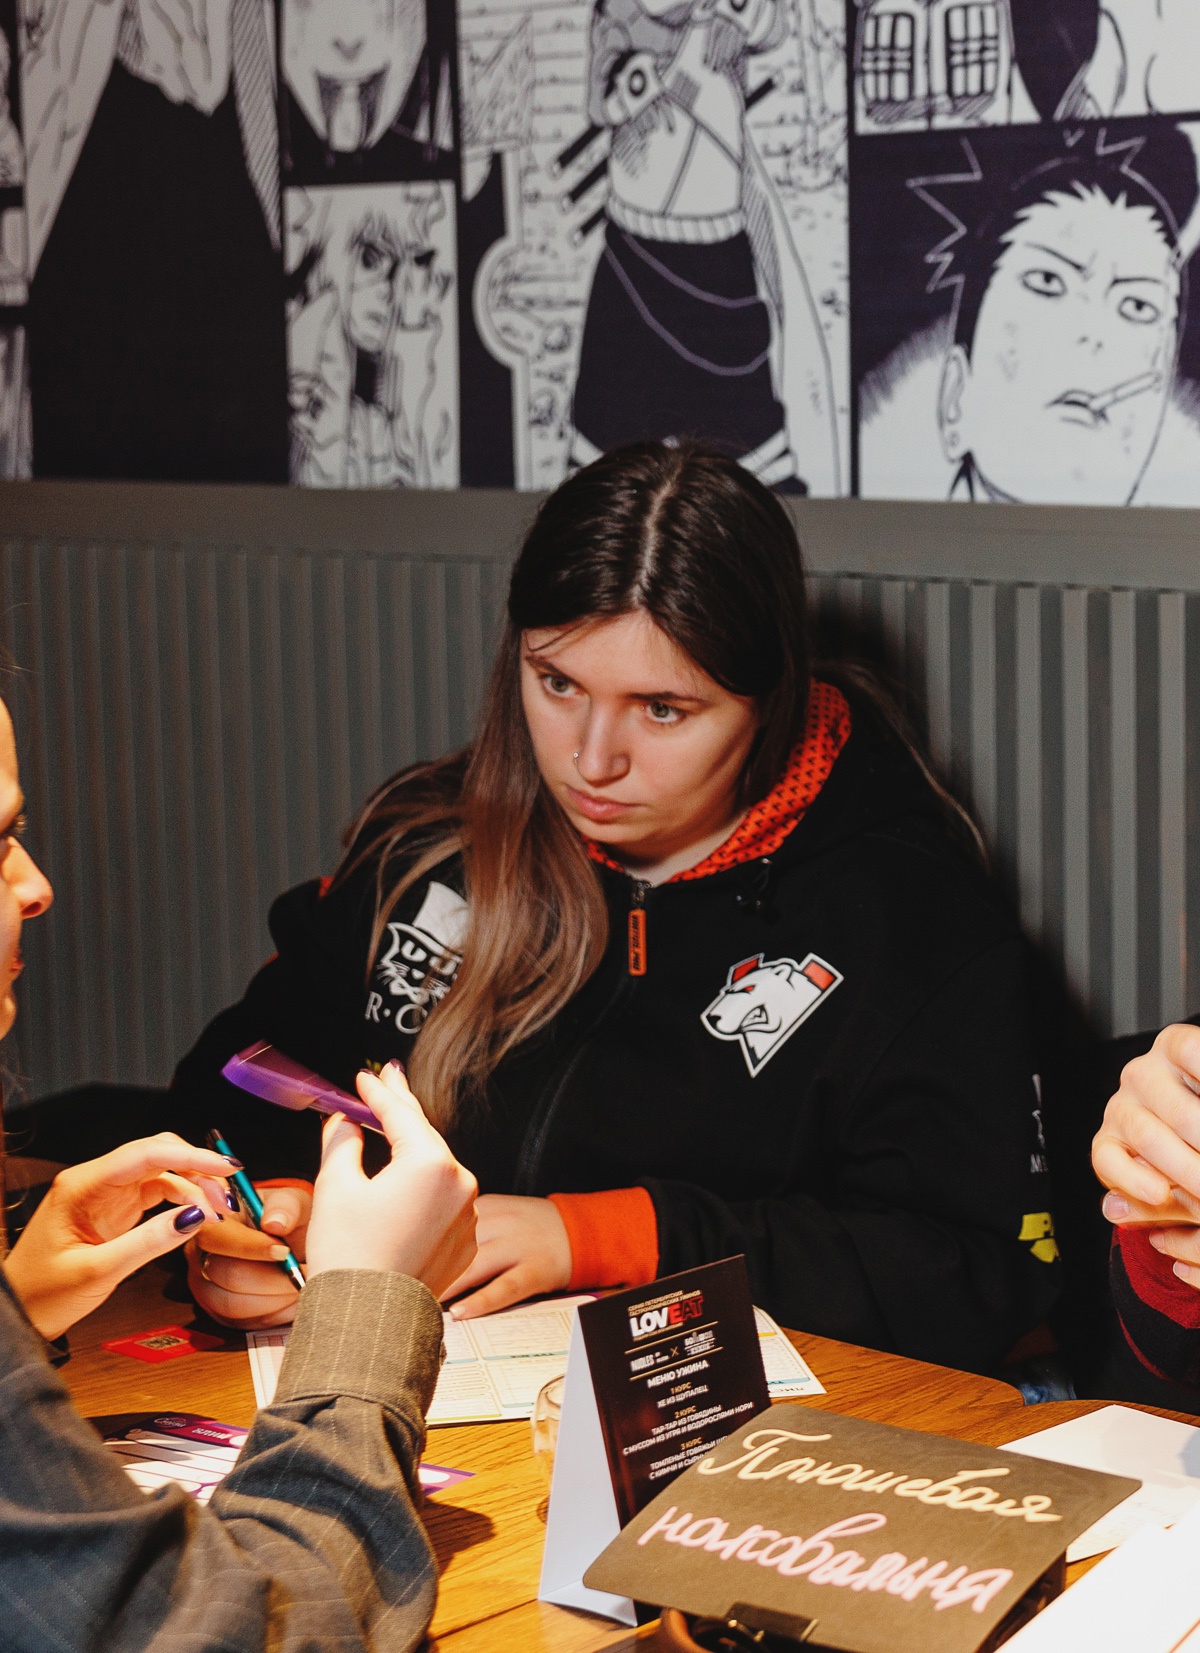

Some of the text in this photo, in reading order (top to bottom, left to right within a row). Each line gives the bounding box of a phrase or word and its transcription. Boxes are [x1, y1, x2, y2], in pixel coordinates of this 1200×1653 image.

[647, 1360, 710, 1388] МЕНЮ УЖИНА
[675, 1382, 692, 1393] КУРС
[676, 1385, 709, 1402] ЩУПАЛЕЦ
[652, 1421, 677, 1435] ТАР-ТАР
[687, 1404, 722, 1423] ГОВЯДИНЫ
[680, 1405, 697, 1417] КУРС
[629, 1437, 656, 1453] МУССОМ
[665, 1428, 680, 1440] УГРЯ
[688, 1409, 735, 1431] ВОДОРОСЛЯМИ
[735, 1401, 754, 1414] НОРИ
[650, 1451, 686, 1470] ТОМЛЕНЫЕ
[687, 1440, 716, 1457] ГОВЯЖЬИ
[686, 1437, 702, 1449] КУРС
[655, 1463, 677, 1478] КИМЧИ
[697, 1428, 1063, 1523] Плюшевая
[636, 1505, 1015, 1613] наковальня
